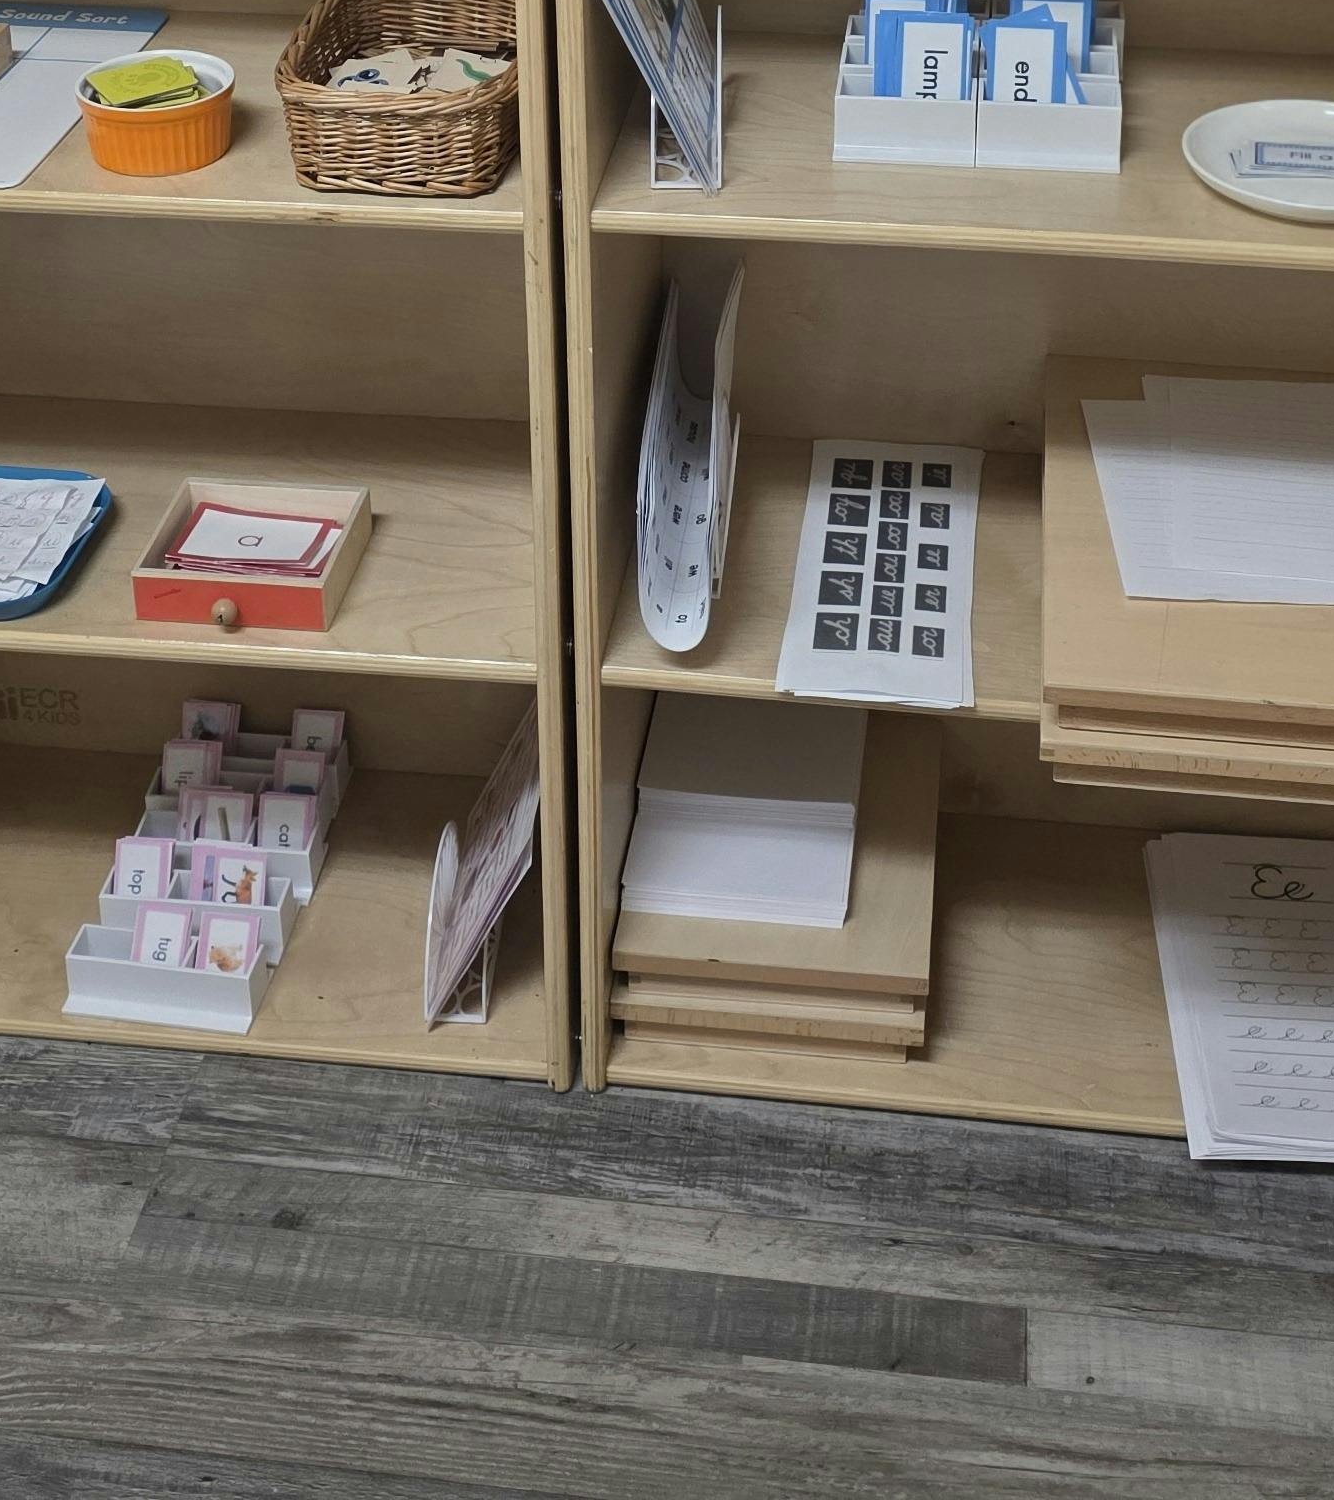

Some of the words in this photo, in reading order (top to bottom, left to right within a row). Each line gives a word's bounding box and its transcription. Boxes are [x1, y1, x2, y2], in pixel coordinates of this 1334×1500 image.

[75, 11, 130, 25] Sort
[1012, 60, 1038, 102] end
[1289, 150, 1312, 160] Fill
[1319, 154, 1334, 162] a
[834, 495, 867, 523] oy
[888, 491, 904, 518] oa
[925, 503, 945, 528] ai
[695, 513, 707, 526] go
[238, 531, 264, 548] a
[831, 536, 860, 561] th
[887, 523, 902, 550] oo
[687, 563, 699, 578] we
[884, 555, 899, 582] ou
[926, 548, 942, 568] ee
[827, 575, 856, 602] sh
[924, 587, 941, 611] er
[675, 614, 688, 625] to
[822, 616, 852, 647] ch
[876, 620, 894, 651] au
[921, 628, 939, 657] or
[19, 686, 80, 711] ECR
[278, 823, 292, 848] cat
[127, 869, 146, 896] top
[1249, 863, 1316, 902] Ee
